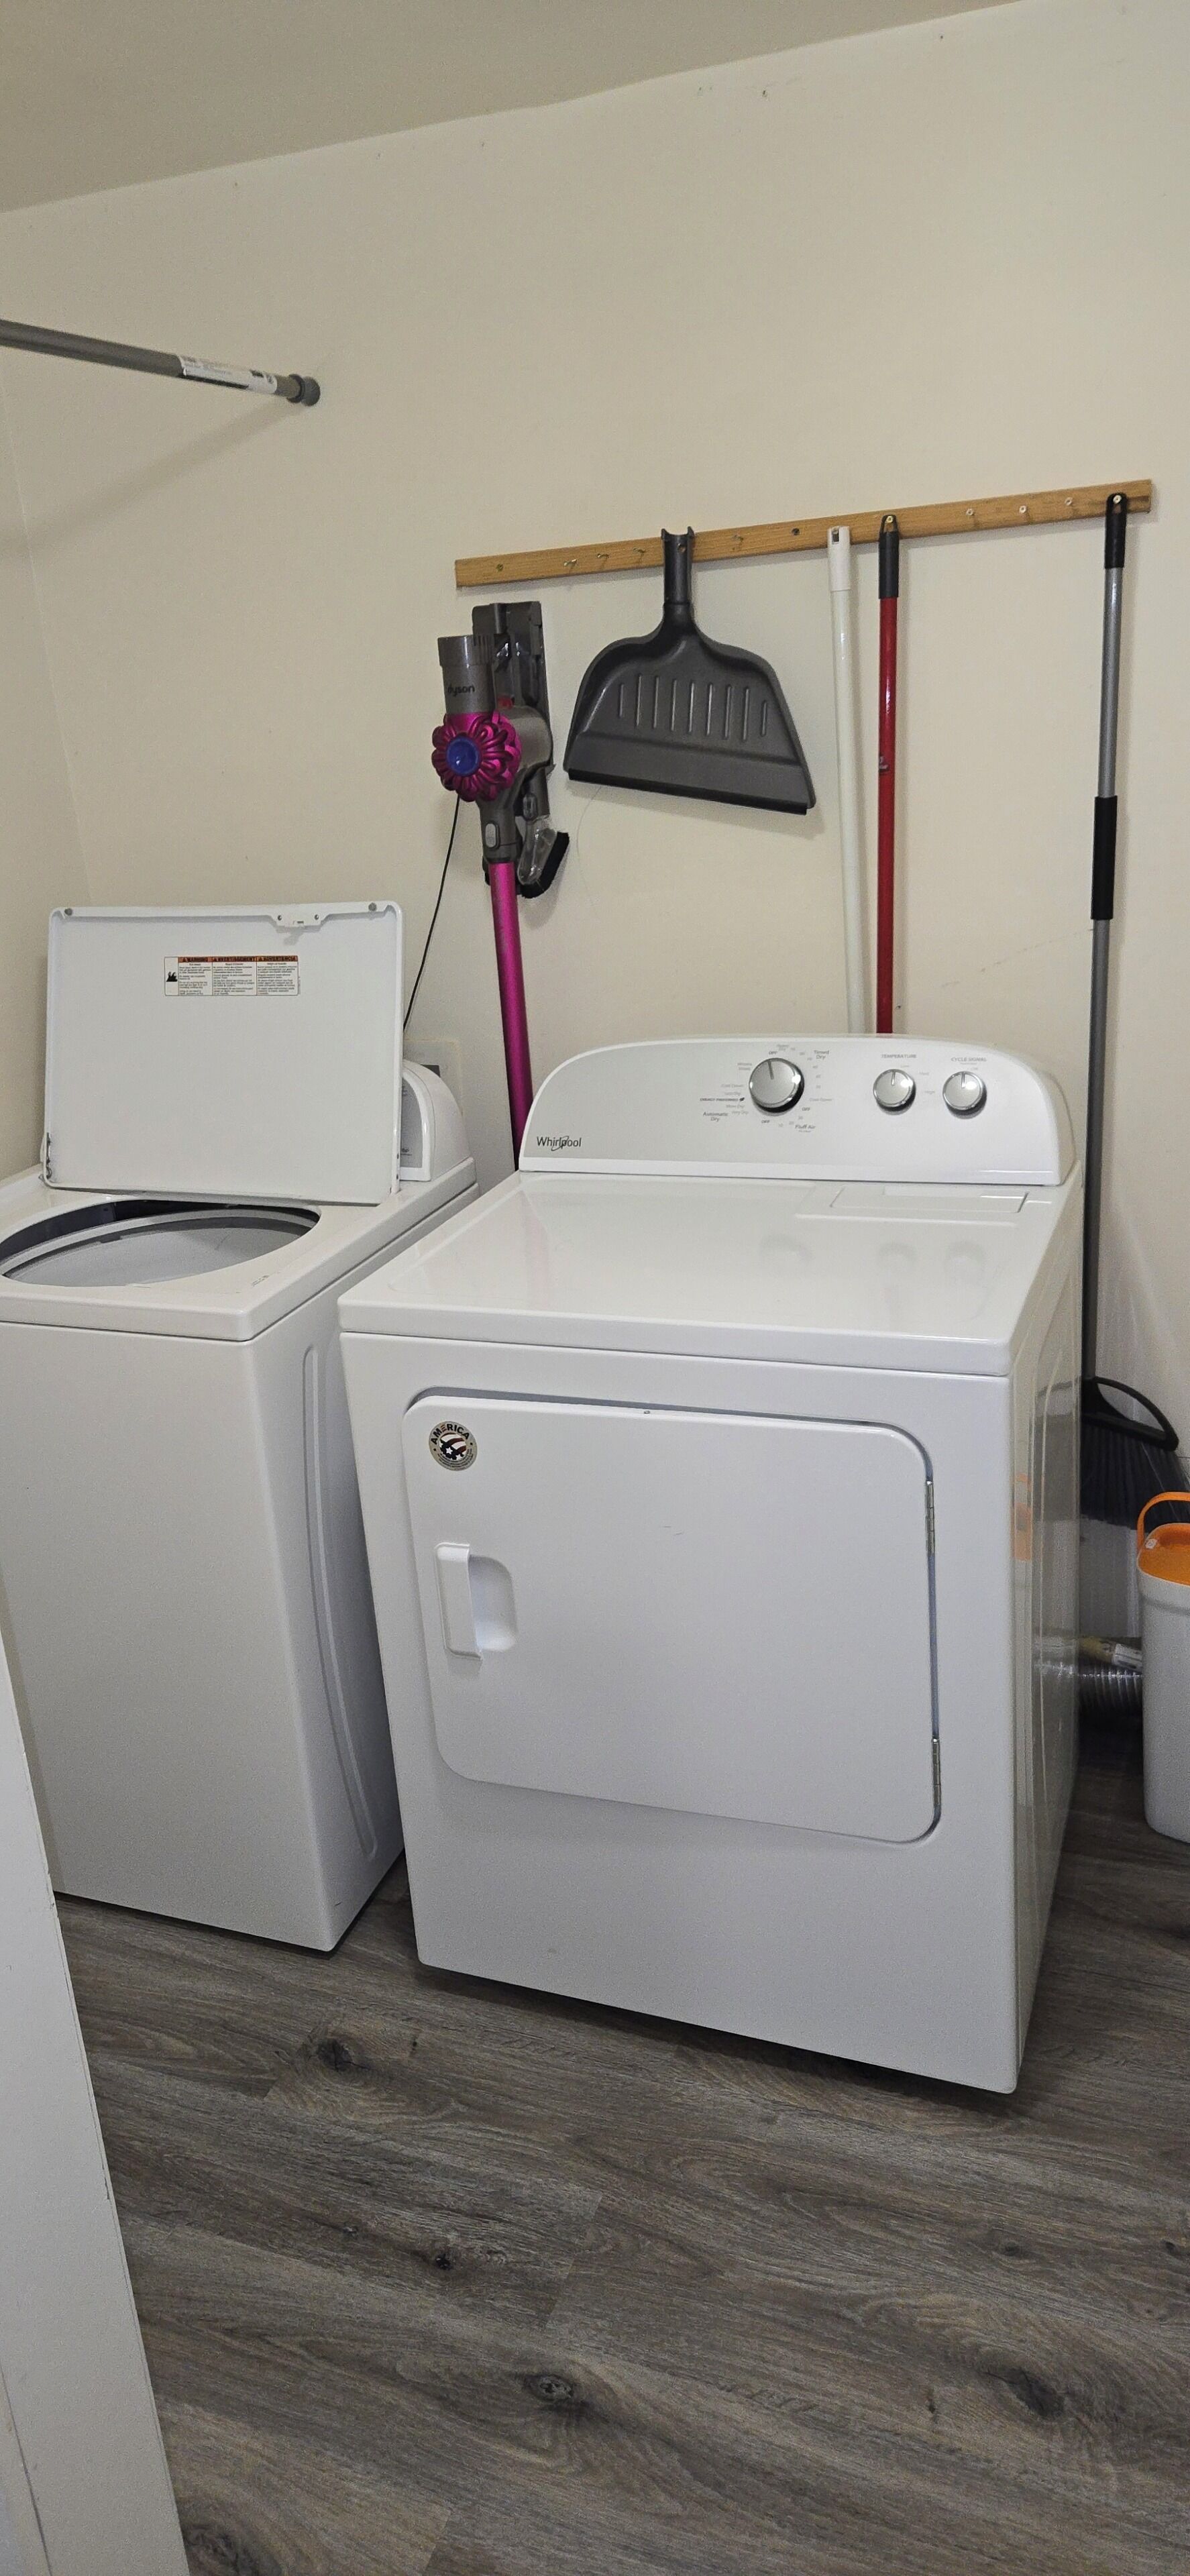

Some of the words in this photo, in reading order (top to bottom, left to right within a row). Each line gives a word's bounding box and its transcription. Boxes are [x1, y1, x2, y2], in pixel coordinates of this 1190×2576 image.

[447, 684, 475, 697] dyson
[536, 1136, 582, 1150] Whirlpool
[431, 1423, 470, 1445] AMERICA
